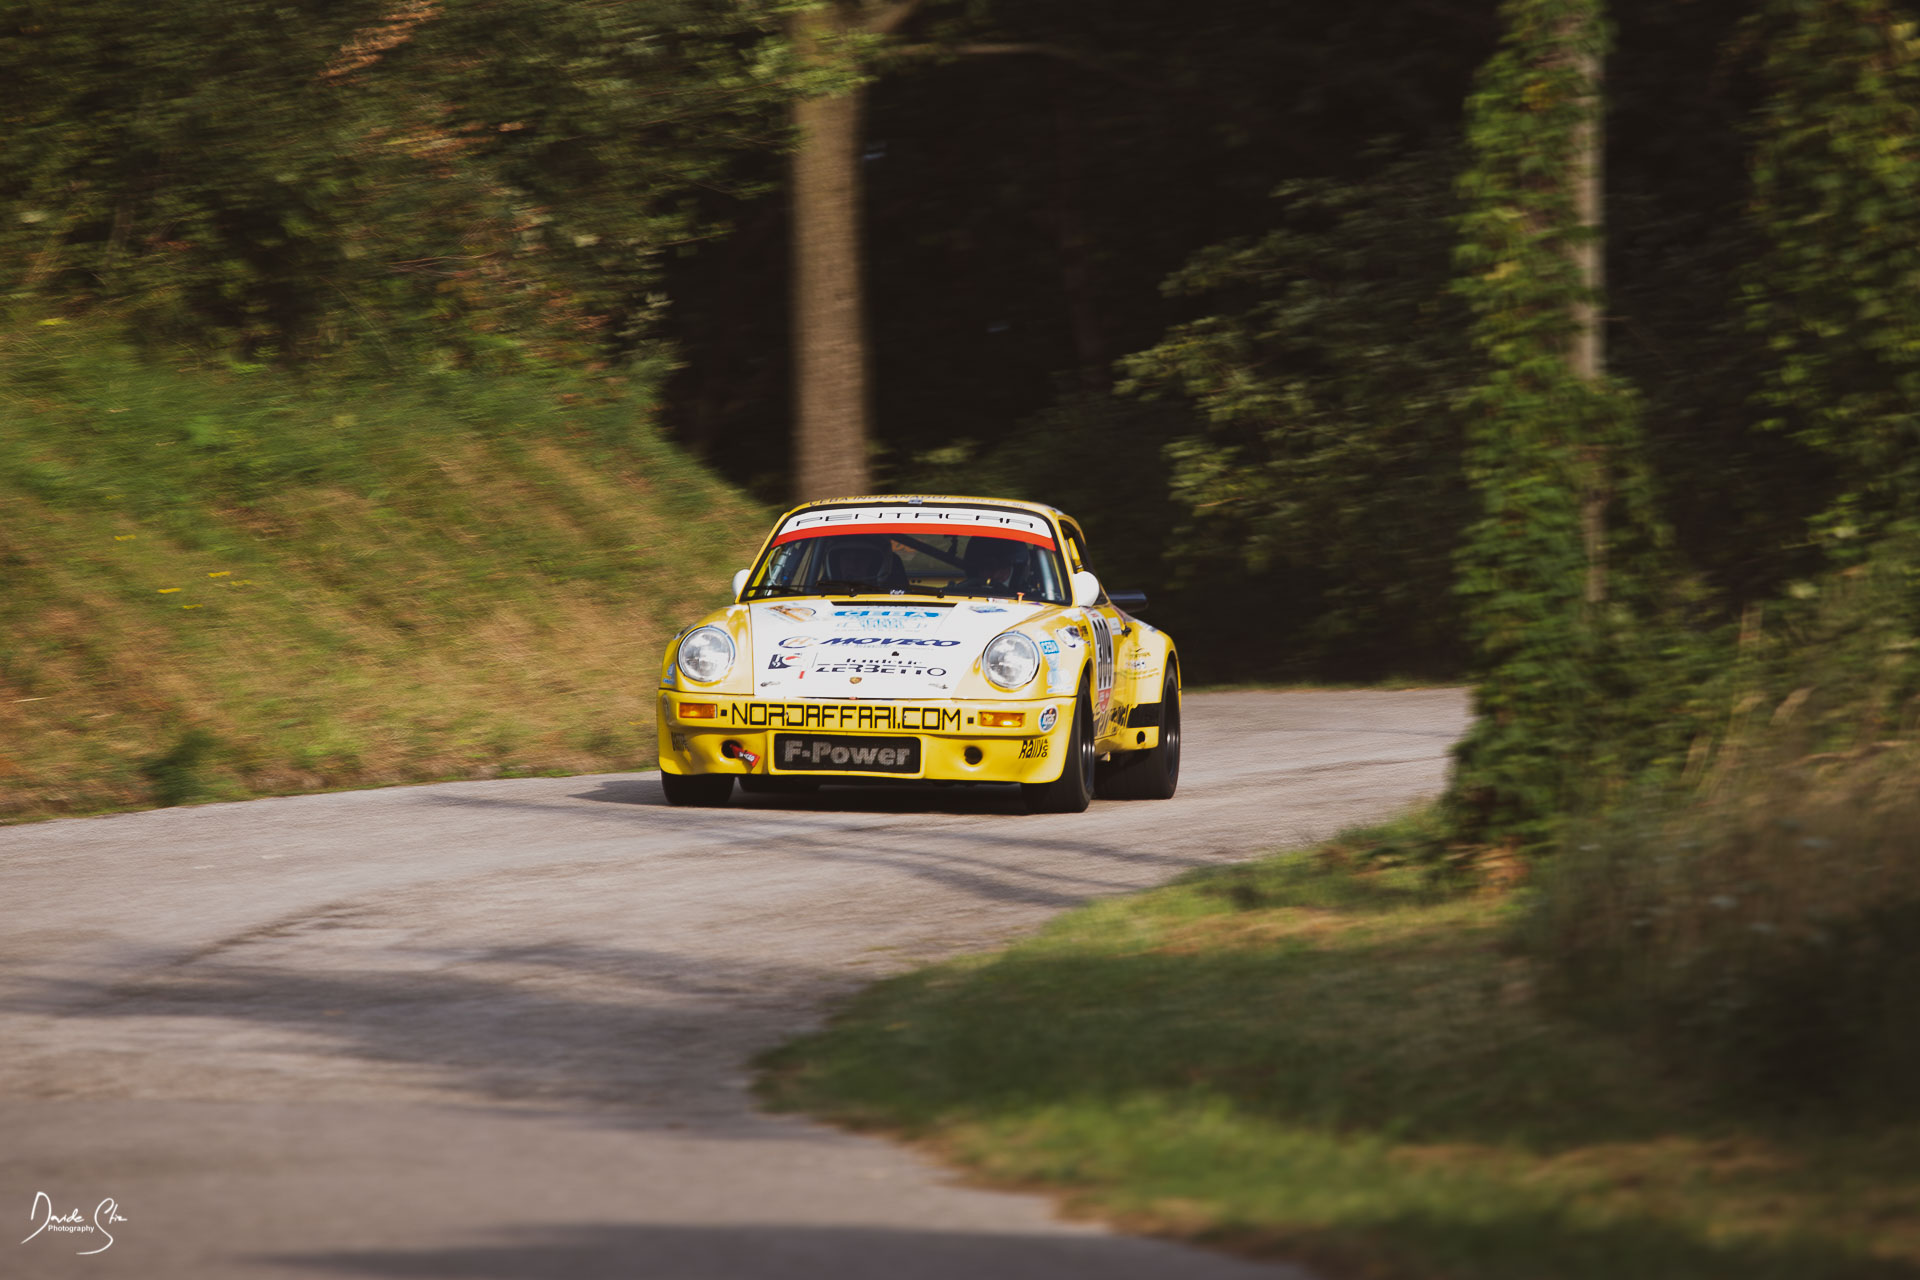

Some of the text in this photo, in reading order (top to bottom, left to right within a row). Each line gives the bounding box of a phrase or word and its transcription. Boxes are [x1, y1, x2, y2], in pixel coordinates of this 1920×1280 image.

[819, 637, 961, 647] MOVECO
[815, 663, 947, 677] ZERBETTO
[731, 702, 961, 731] NORDAFFARI.COM
[783, 740, 910, 766] F-Power
